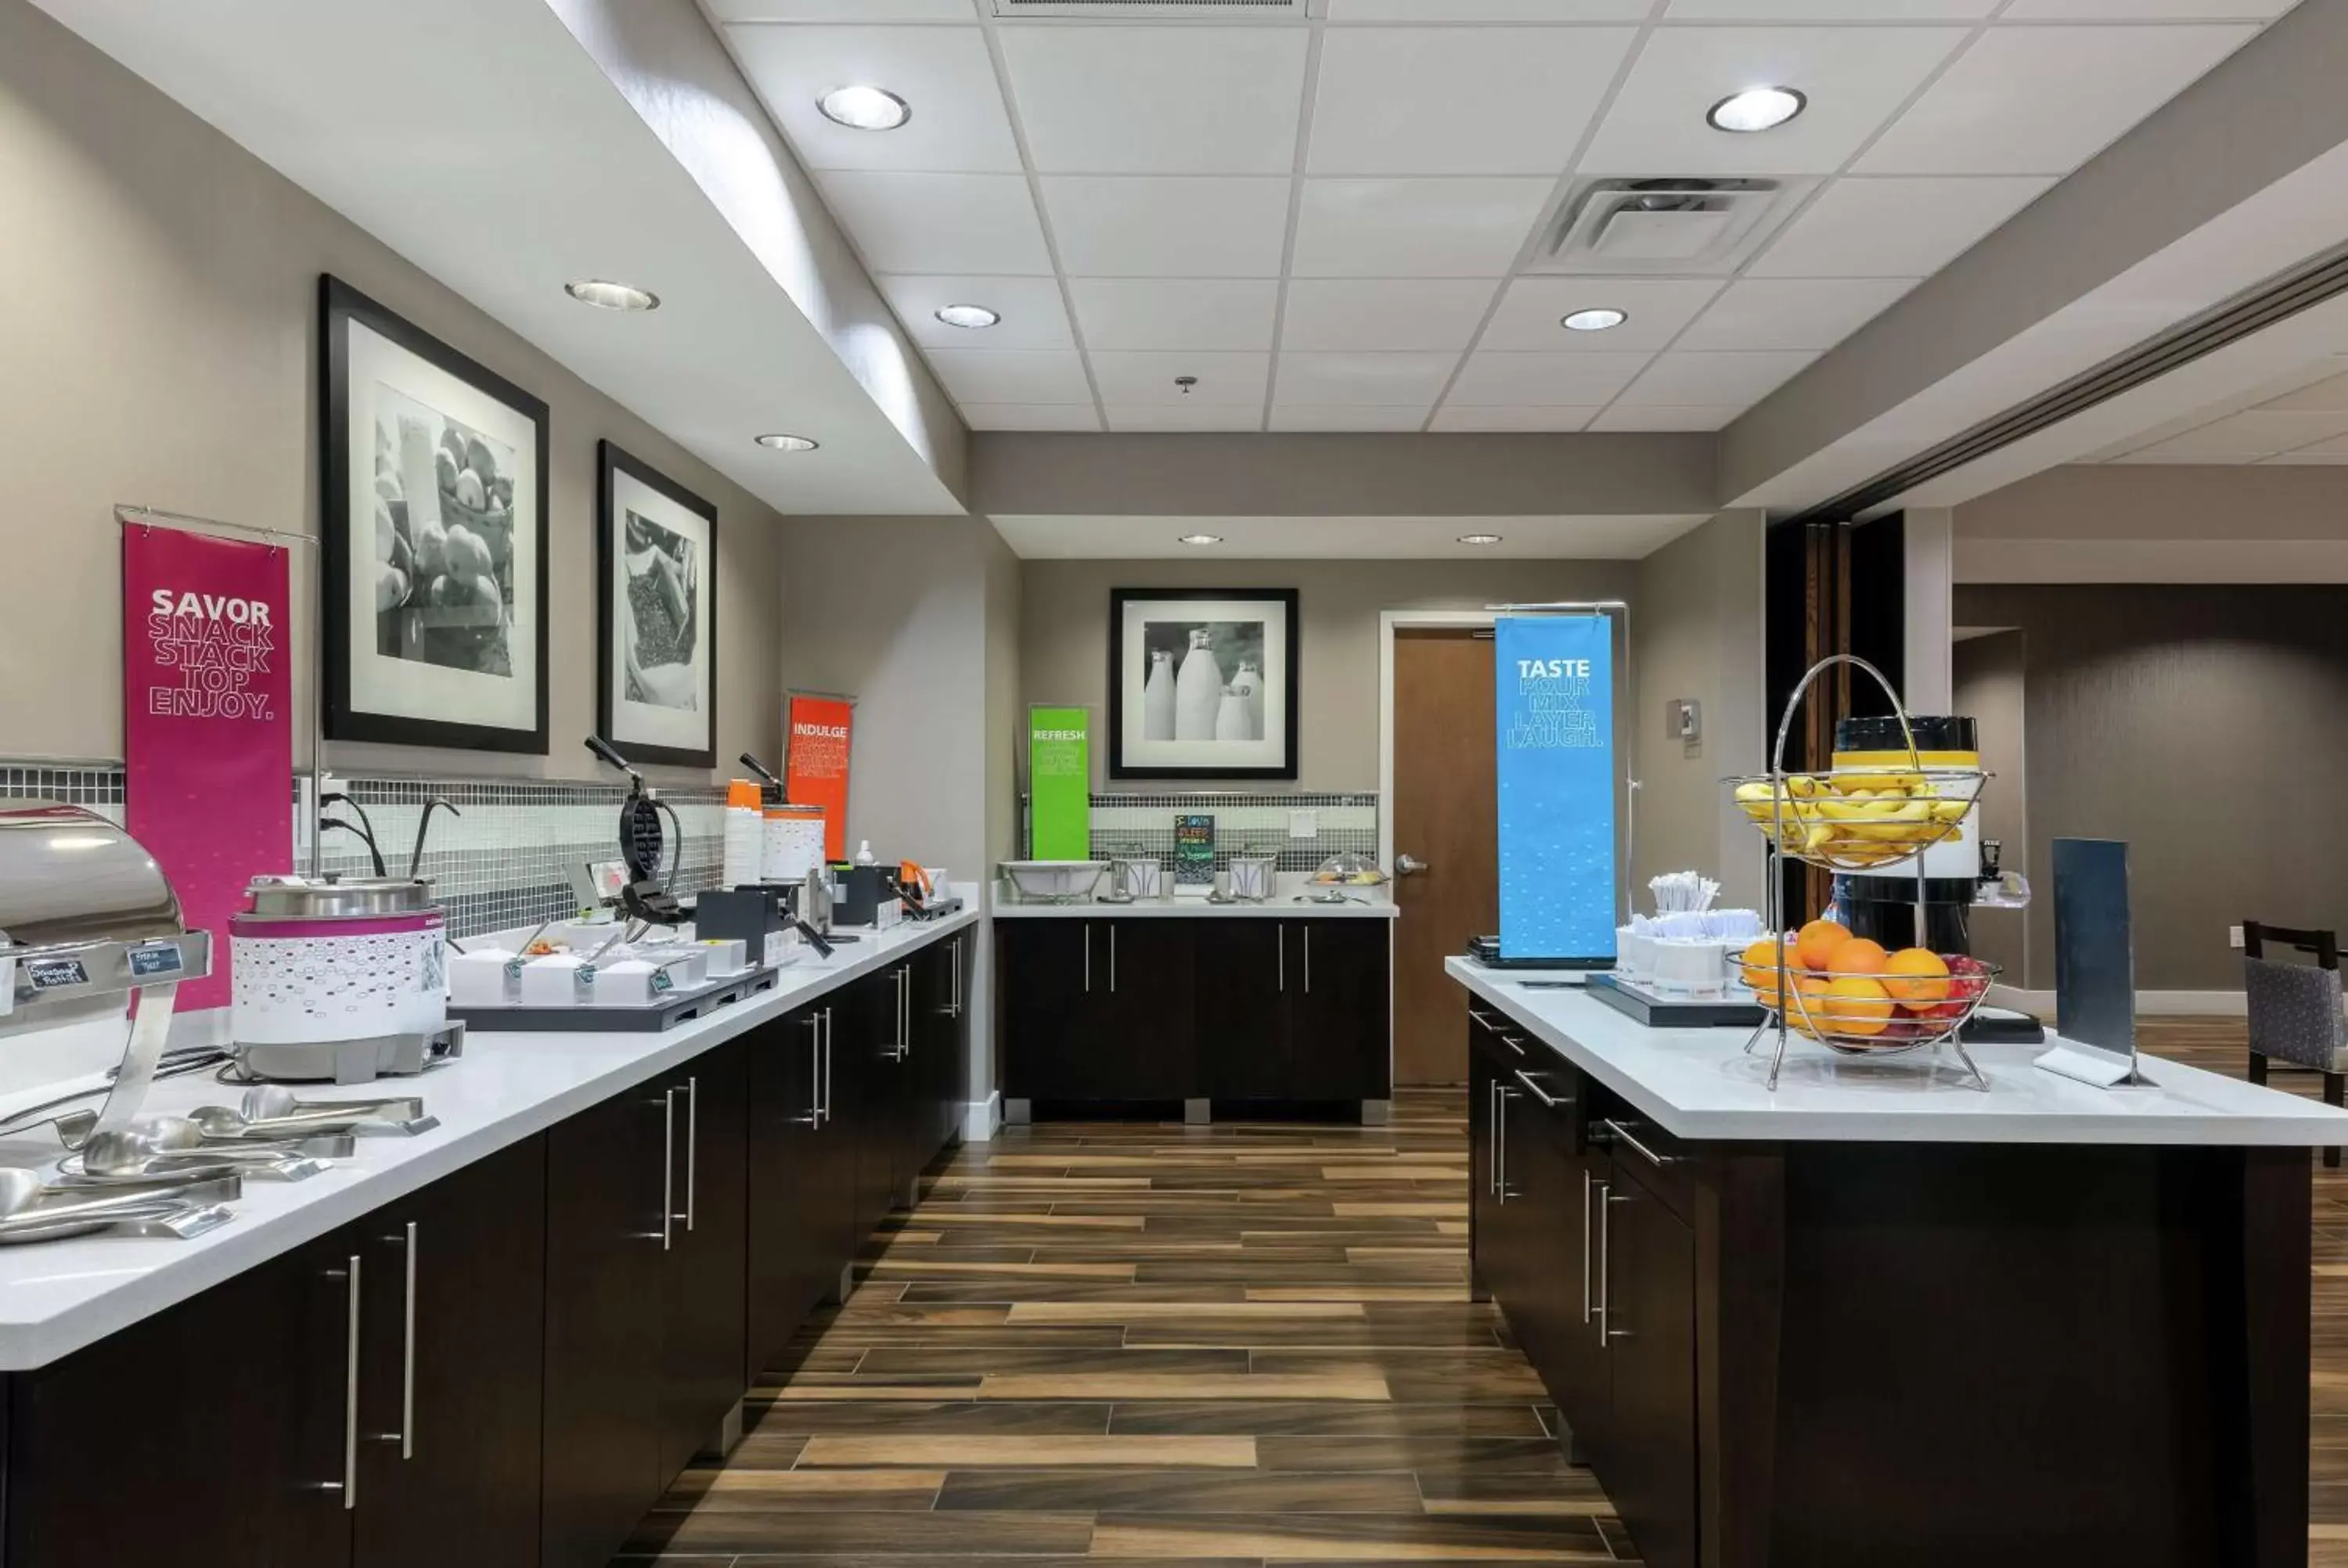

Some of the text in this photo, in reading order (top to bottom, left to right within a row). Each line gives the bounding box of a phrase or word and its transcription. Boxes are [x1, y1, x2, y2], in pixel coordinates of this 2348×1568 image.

[152, 589, 270, 627] SAVOR
[148, 612, 274, 649] SNACK
[154, 638, 271, 674] STACK
[179, 664, 250, 693] TOP
[1517, 660, 1590, 678] TASTE
[1519, 677, 1590, 696] POUR
[149, 686, 274, 720] ENJOY.
[1529, 692, 1579, 713] MIX
[794, 722, 848, 738] INDULGE
[1514, 710, 1597, 731] LAYER
[1034, 730, 1086, 740] REFRESH
